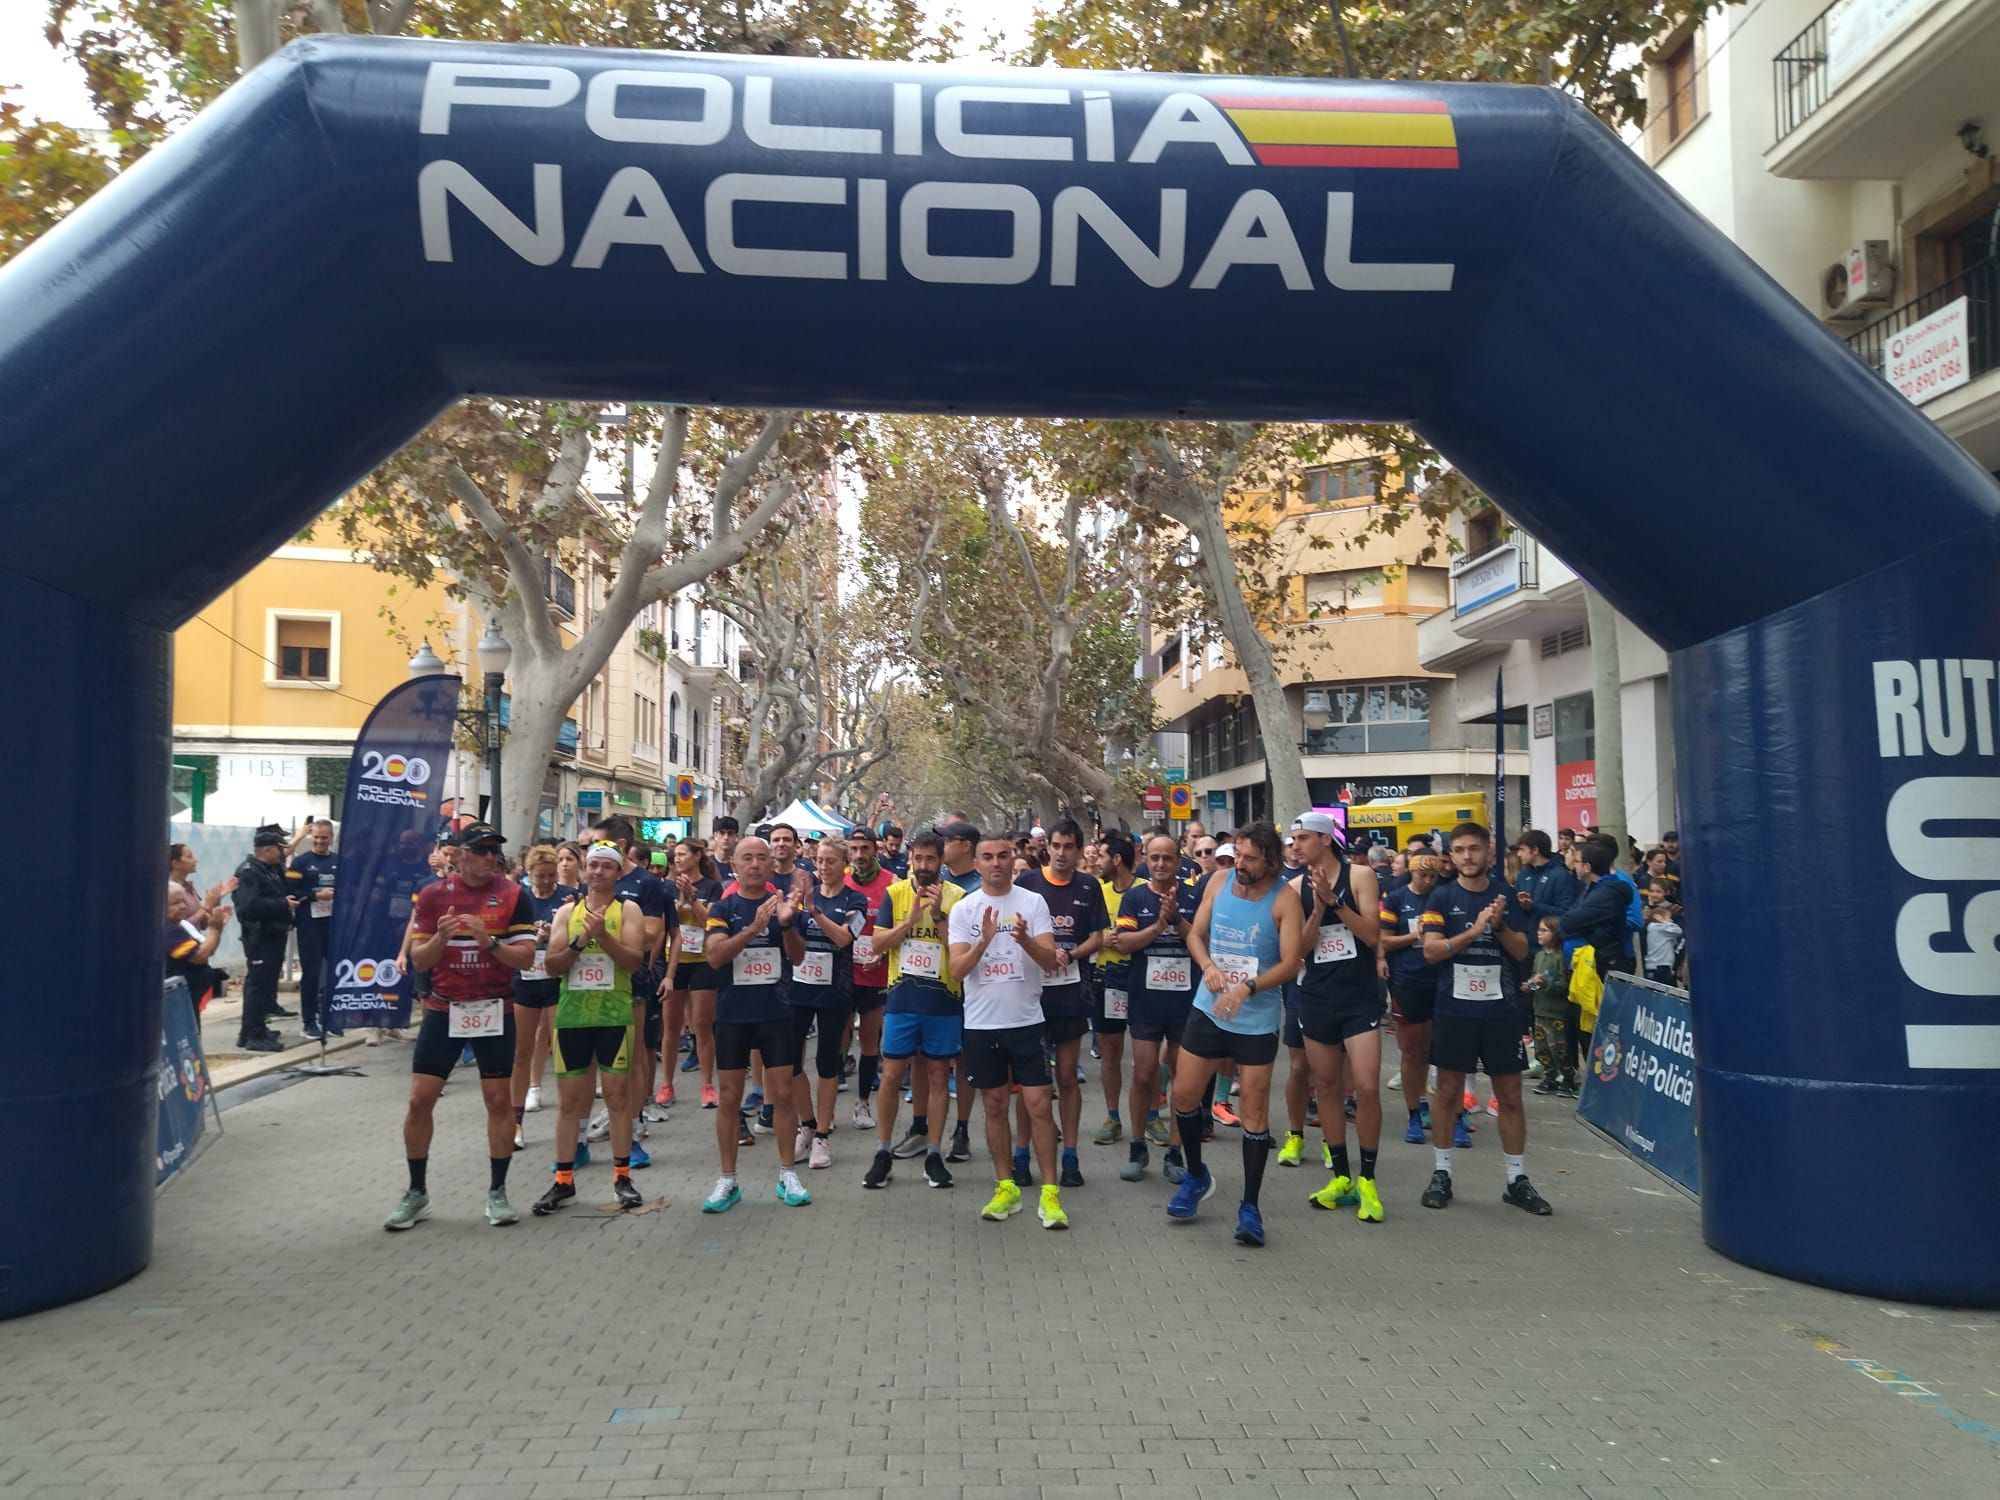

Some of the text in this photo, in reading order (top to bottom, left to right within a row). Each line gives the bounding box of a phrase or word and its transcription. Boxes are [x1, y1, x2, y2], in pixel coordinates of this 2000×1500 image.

[418, 160, 1455, 291] NACIONAL
[1909, 336, 1960, 370] ALQUILA
[1873, 659, 2000, 757] RUT
[361, 751, 430, 785] 200
[1572, 774, 1595, 786] LOCAL
[1354, 785, 1409, 797] MACSON
[357, 793, 425, 808] NACIONAL
[907, 955, 931, 968] 480
[577, 969, 604, 981] 150
[744, 963, 772, 976] 499
[801, 966, 823, 977] 478
[984, 963, 1015, 976] 3401
[1153, 971, 1186, 982] 2496
[1469, 980, 1487, 992] 59
[329, 1002, 398, 1012] NACIONAL
[461, 1015, 492, 1028] 387
[1625, 1045, 1639, 1078] de
[1643, 1055, 1694, 1107] Policía
